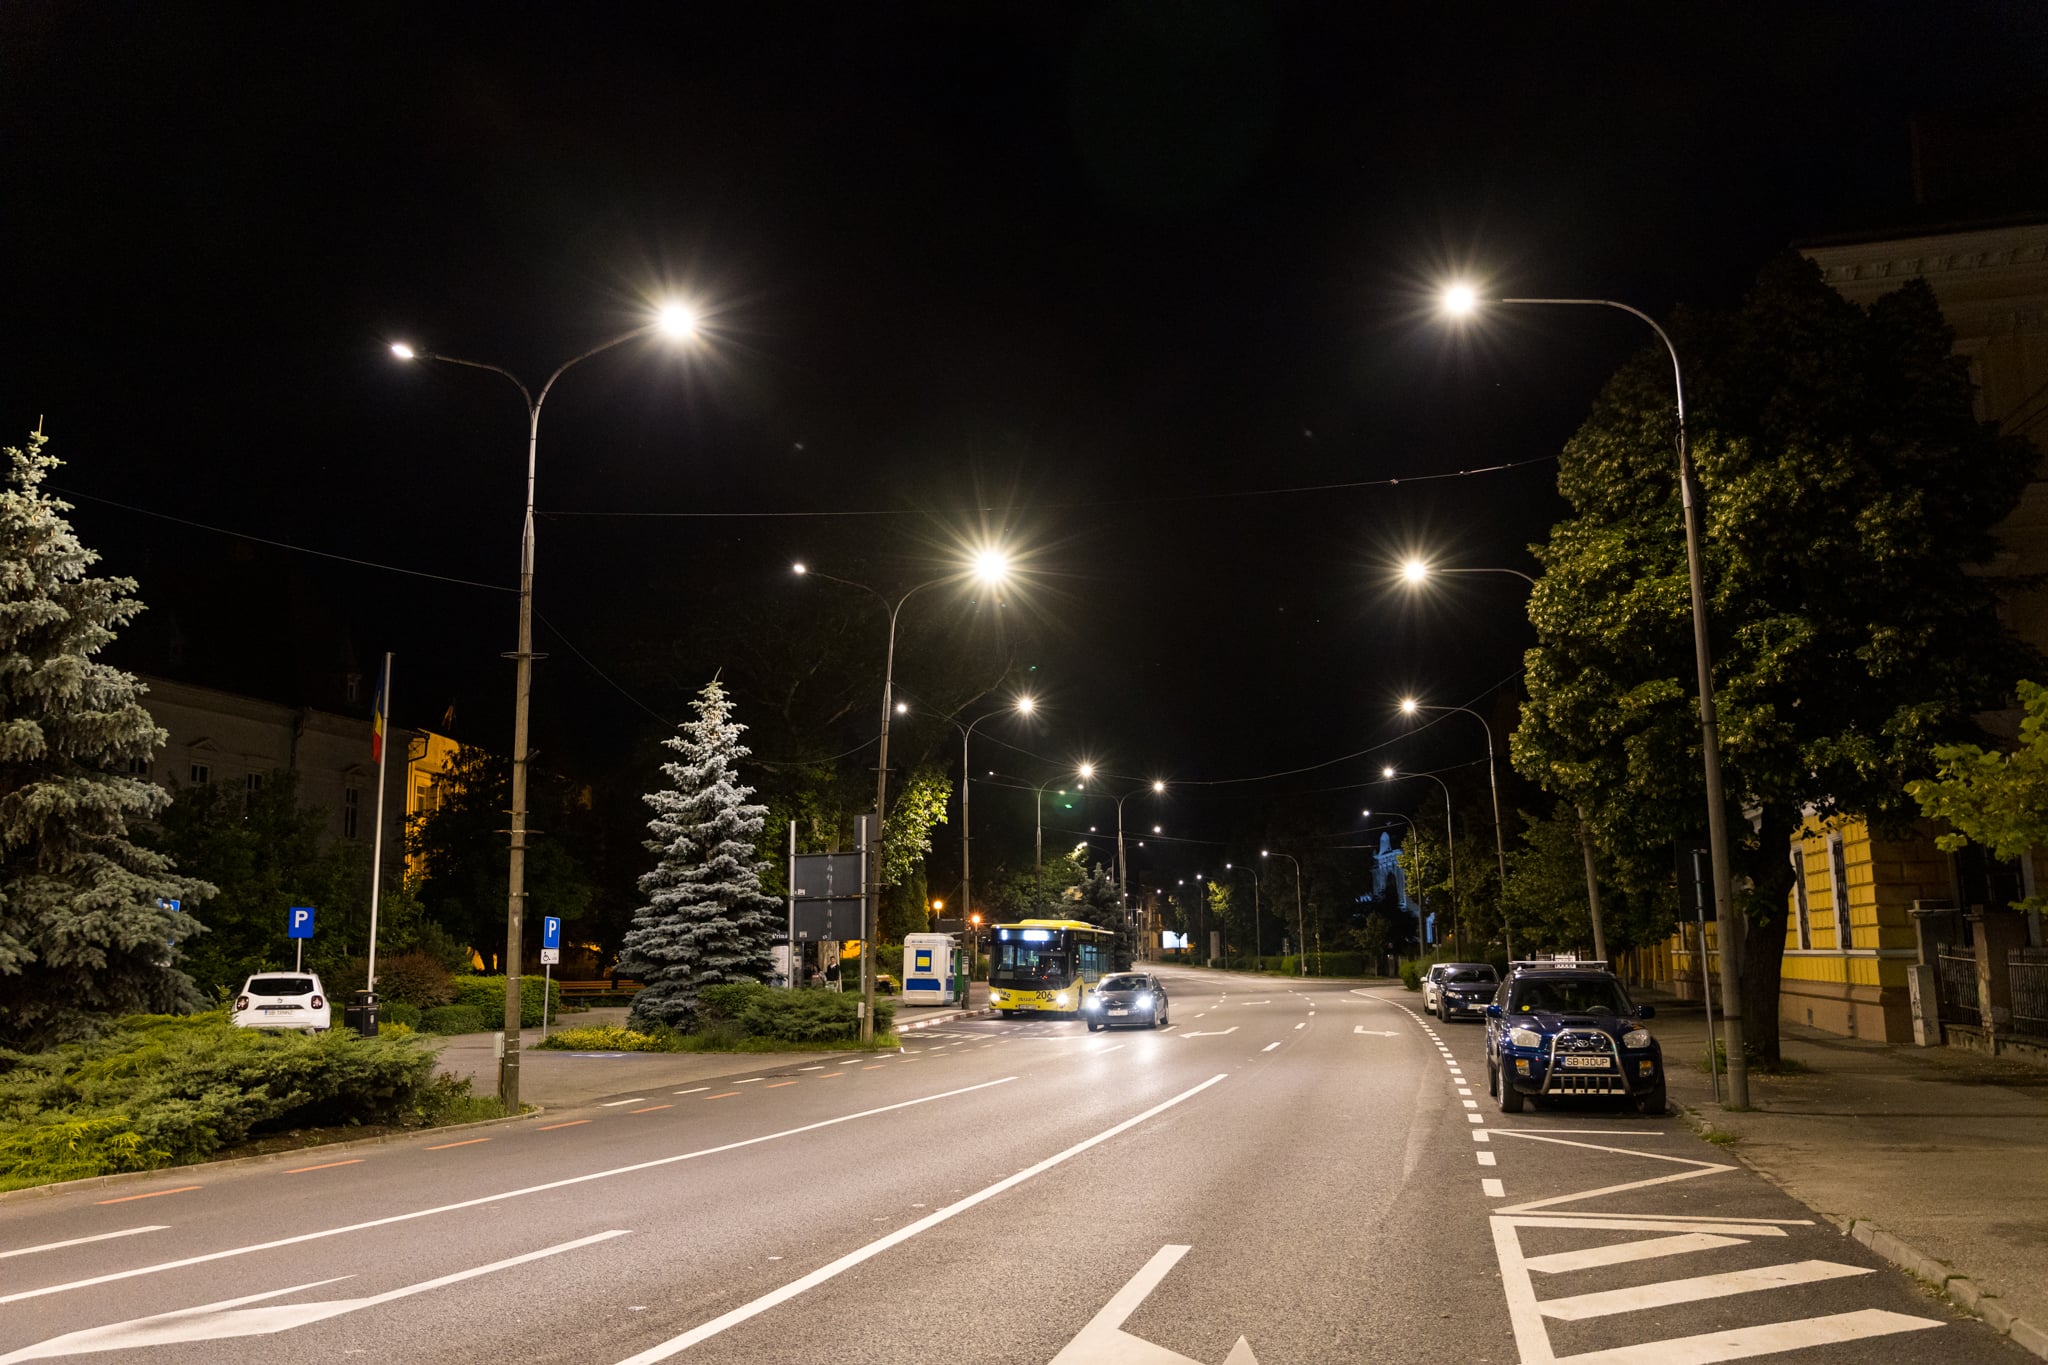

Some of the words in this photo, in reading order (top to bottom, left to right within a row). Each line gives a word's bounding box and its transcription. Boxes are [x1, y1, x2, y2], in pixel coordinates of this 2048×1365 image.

[295, 910, 309, 928] P
[548, 919, 557, 938] P
[1036, 991, 1053, 1000] 206
[1566, 1057, 1579, 1066] SB
